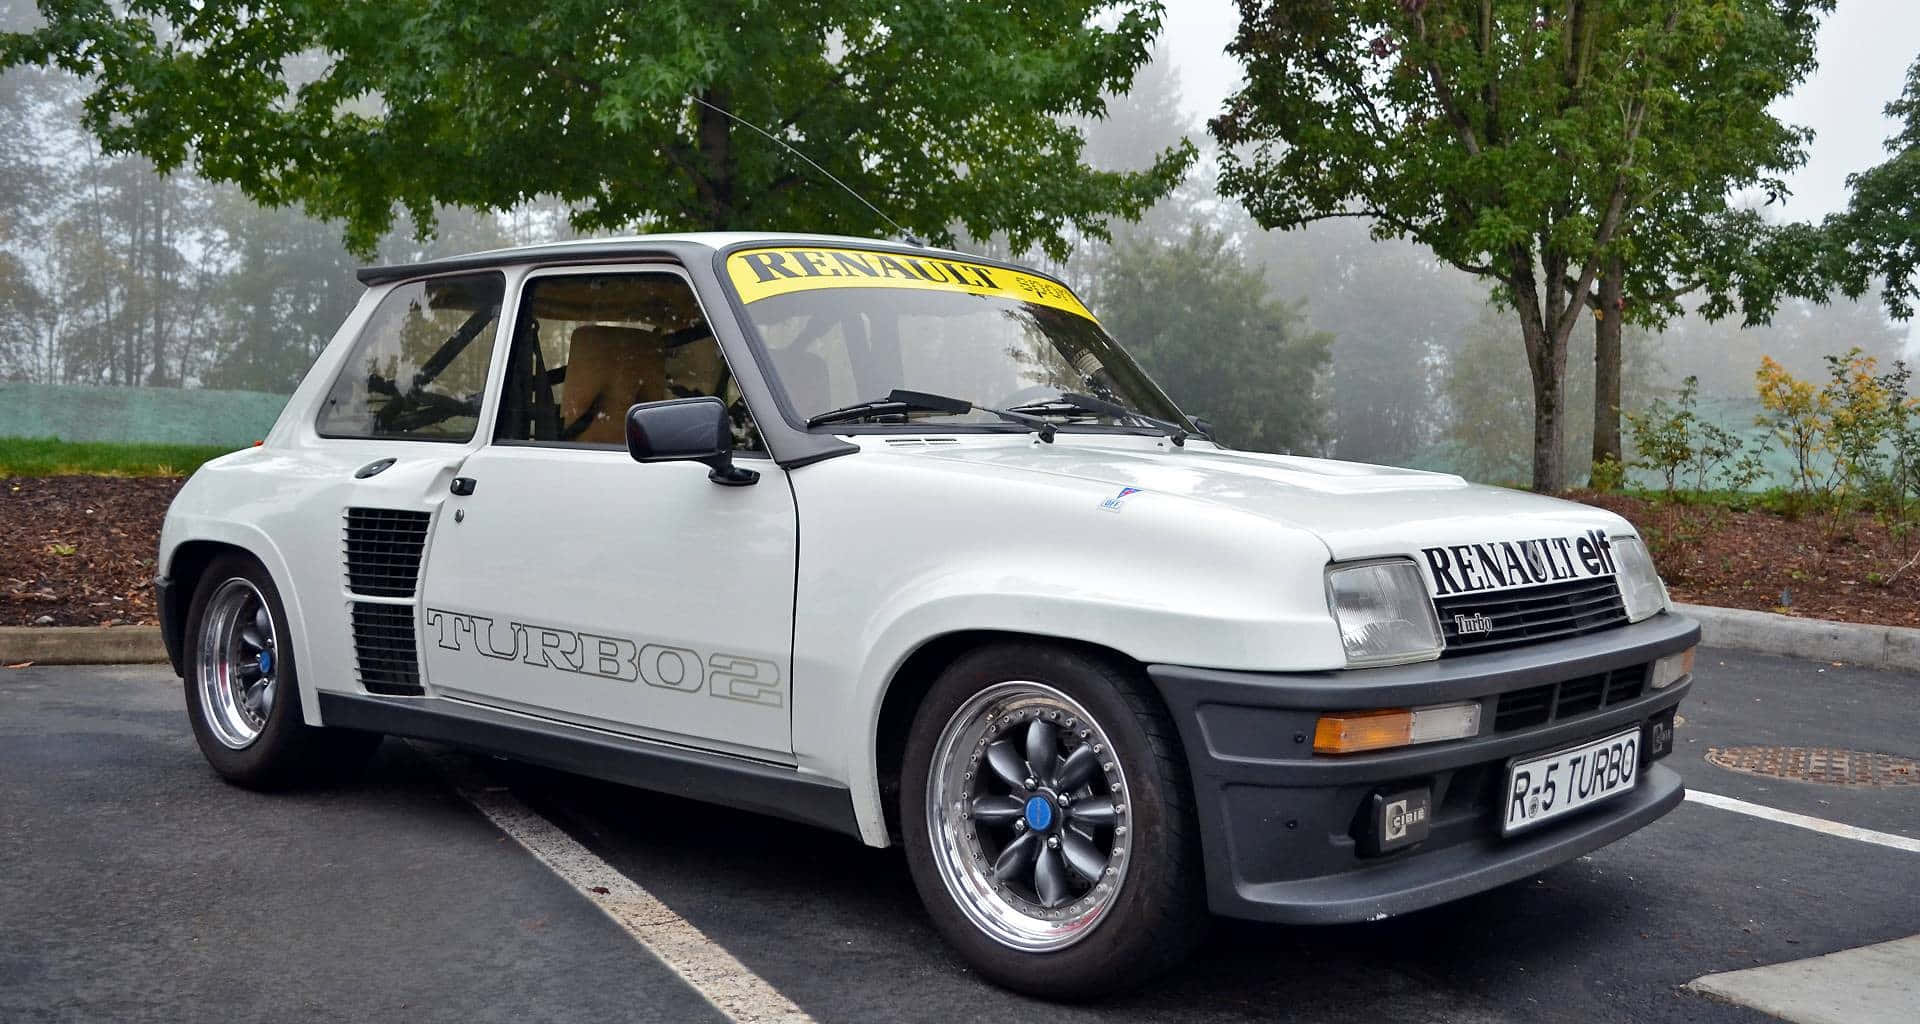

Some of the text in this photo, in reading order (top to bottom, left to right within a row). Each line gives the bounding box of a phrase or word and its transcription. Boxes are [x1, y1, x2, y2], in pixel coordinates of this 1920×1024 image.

[739, 250, 1001, 289] RENAULT
[1421, 529, 1616, 595] RENAULT elf
[1454, 612, 1493, 638] Turbo
[1509, 738, 1636, 822] R-5 TURBO
